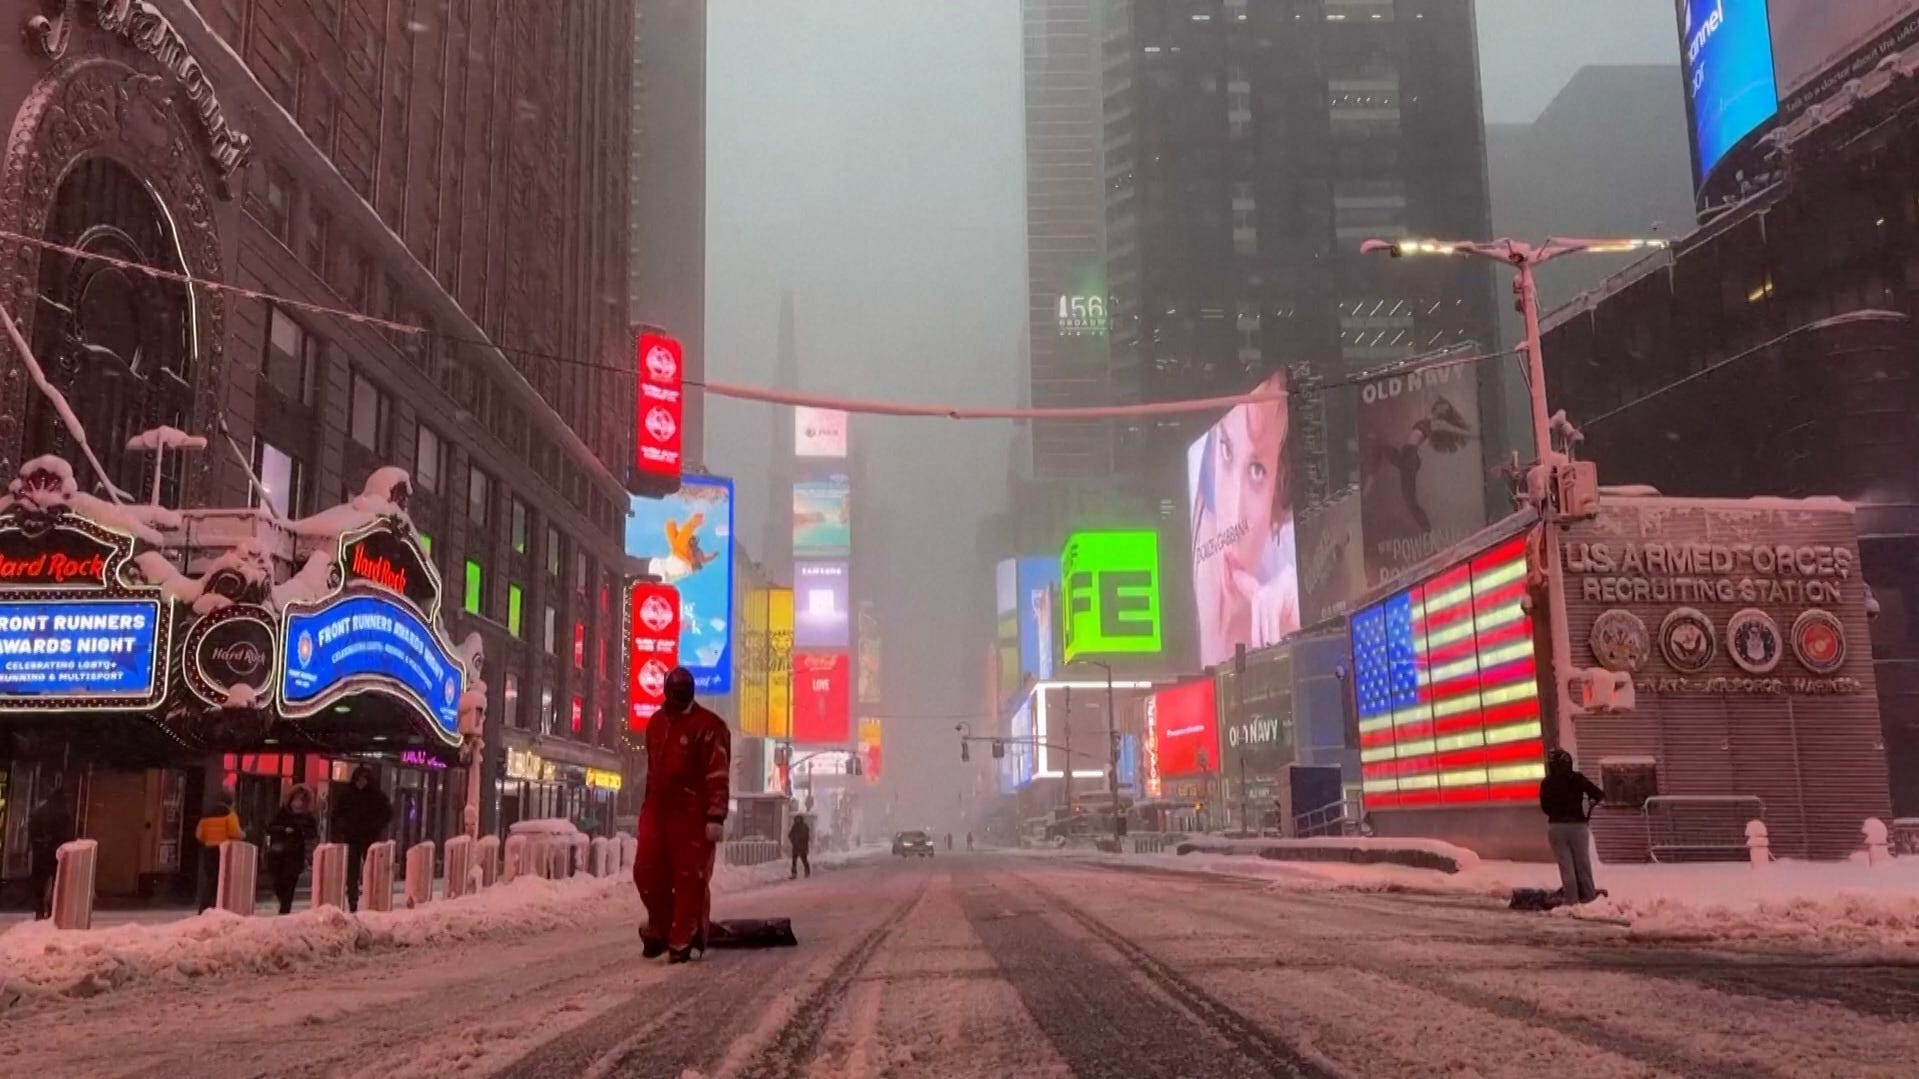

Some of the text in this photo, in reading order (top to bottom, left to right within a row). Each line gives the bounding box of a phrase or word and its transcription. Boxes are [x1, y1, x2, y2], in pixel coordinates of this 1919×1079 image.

[1362, 365, 1465, 404] OLD NAVY
[47, 552, 106, 583] Rock
[1620, 543, 1733, 574] ARMED
[1734, 544, 1852, 580] FORCES
[1583, 577, 1842, 603] RECRUITING STATION
[0, 614, 146, 631] RONT RUNNERS
[317, 616, 350, 648] FRONT
[352, 615, 393, 634] RUNNERS
[76, 637, 137, 654] NIGHT
[211, 647, 245, 660] Hard
[5, 661, 75, 671] CELEBRATING
[58, 672, 124, 682] MULTISPORT
[1250, 717, 1279, 745] NAVY
